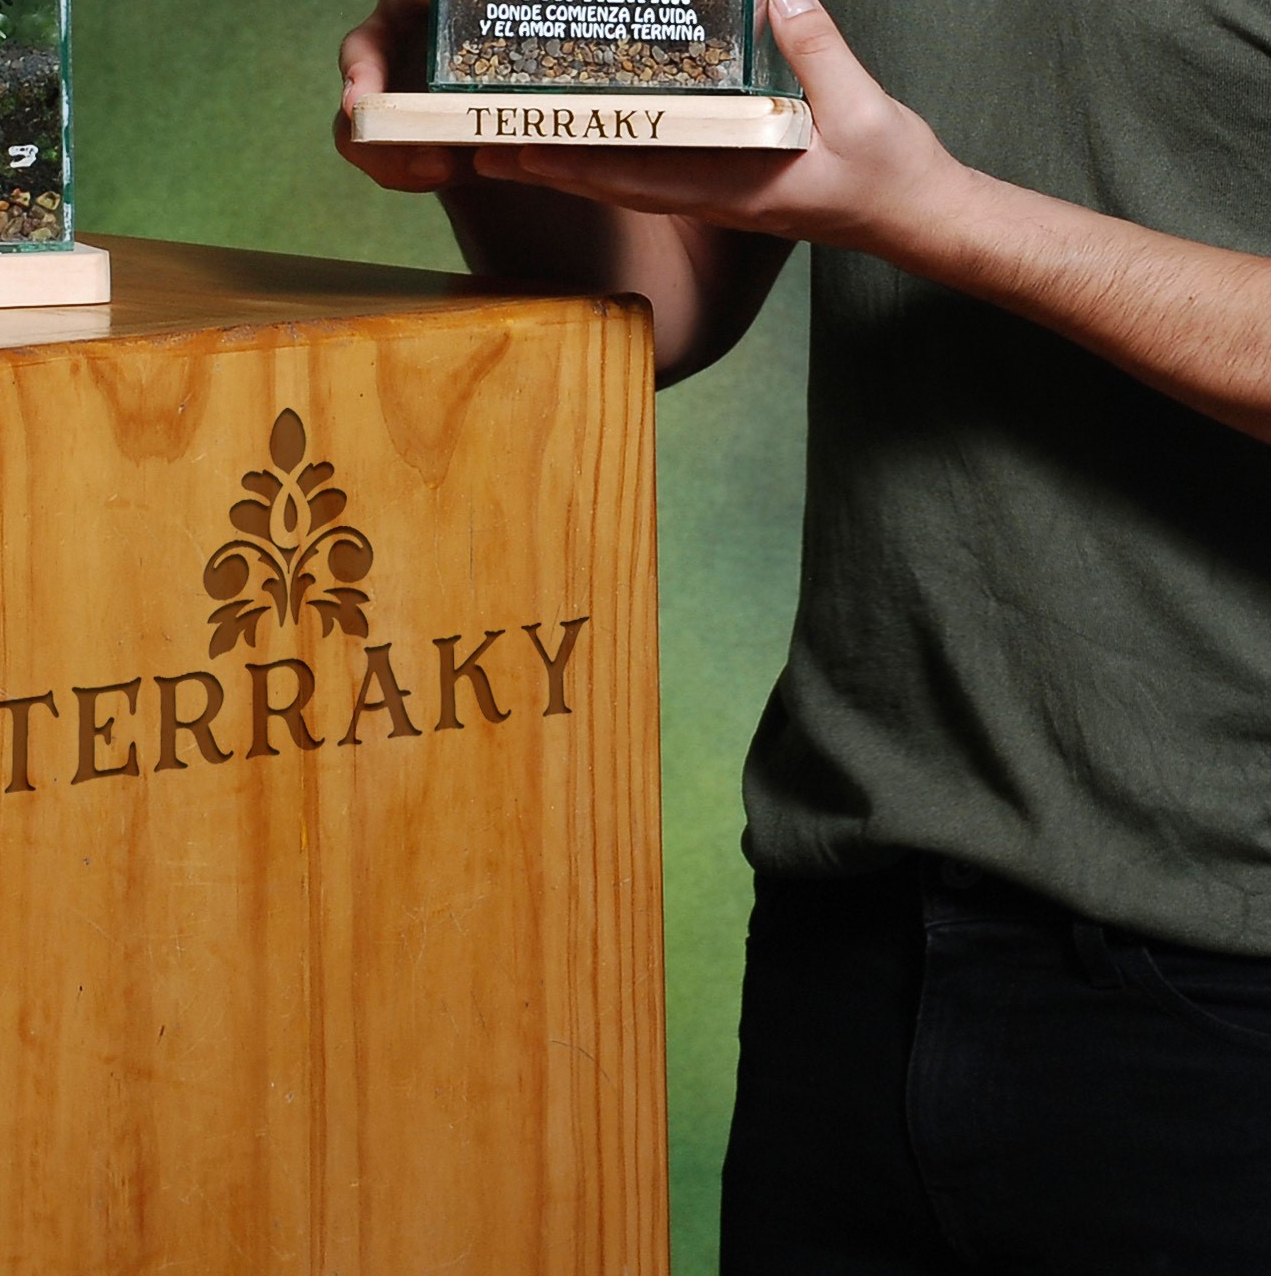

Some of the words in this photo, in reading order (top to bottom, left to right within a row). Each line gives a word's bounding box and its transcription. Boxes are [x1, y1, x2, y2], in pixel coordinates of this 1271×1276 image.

[486, 2, 542, 21] DONDE
[546, 4, 630, 23] COMIENZA
[634, 6, 655, 23] LA
[659, 7, 698, 25] VIDA
[480, 19, 490, 36] Y
[494, 20, 515, 37] EL
[518, 21, 566, 39] AMOR
[570, 22, 628, 40] NUNCA
[631, 24, 706, 41] TERMINA
[467, 106, 666, 140] TERRAKY
